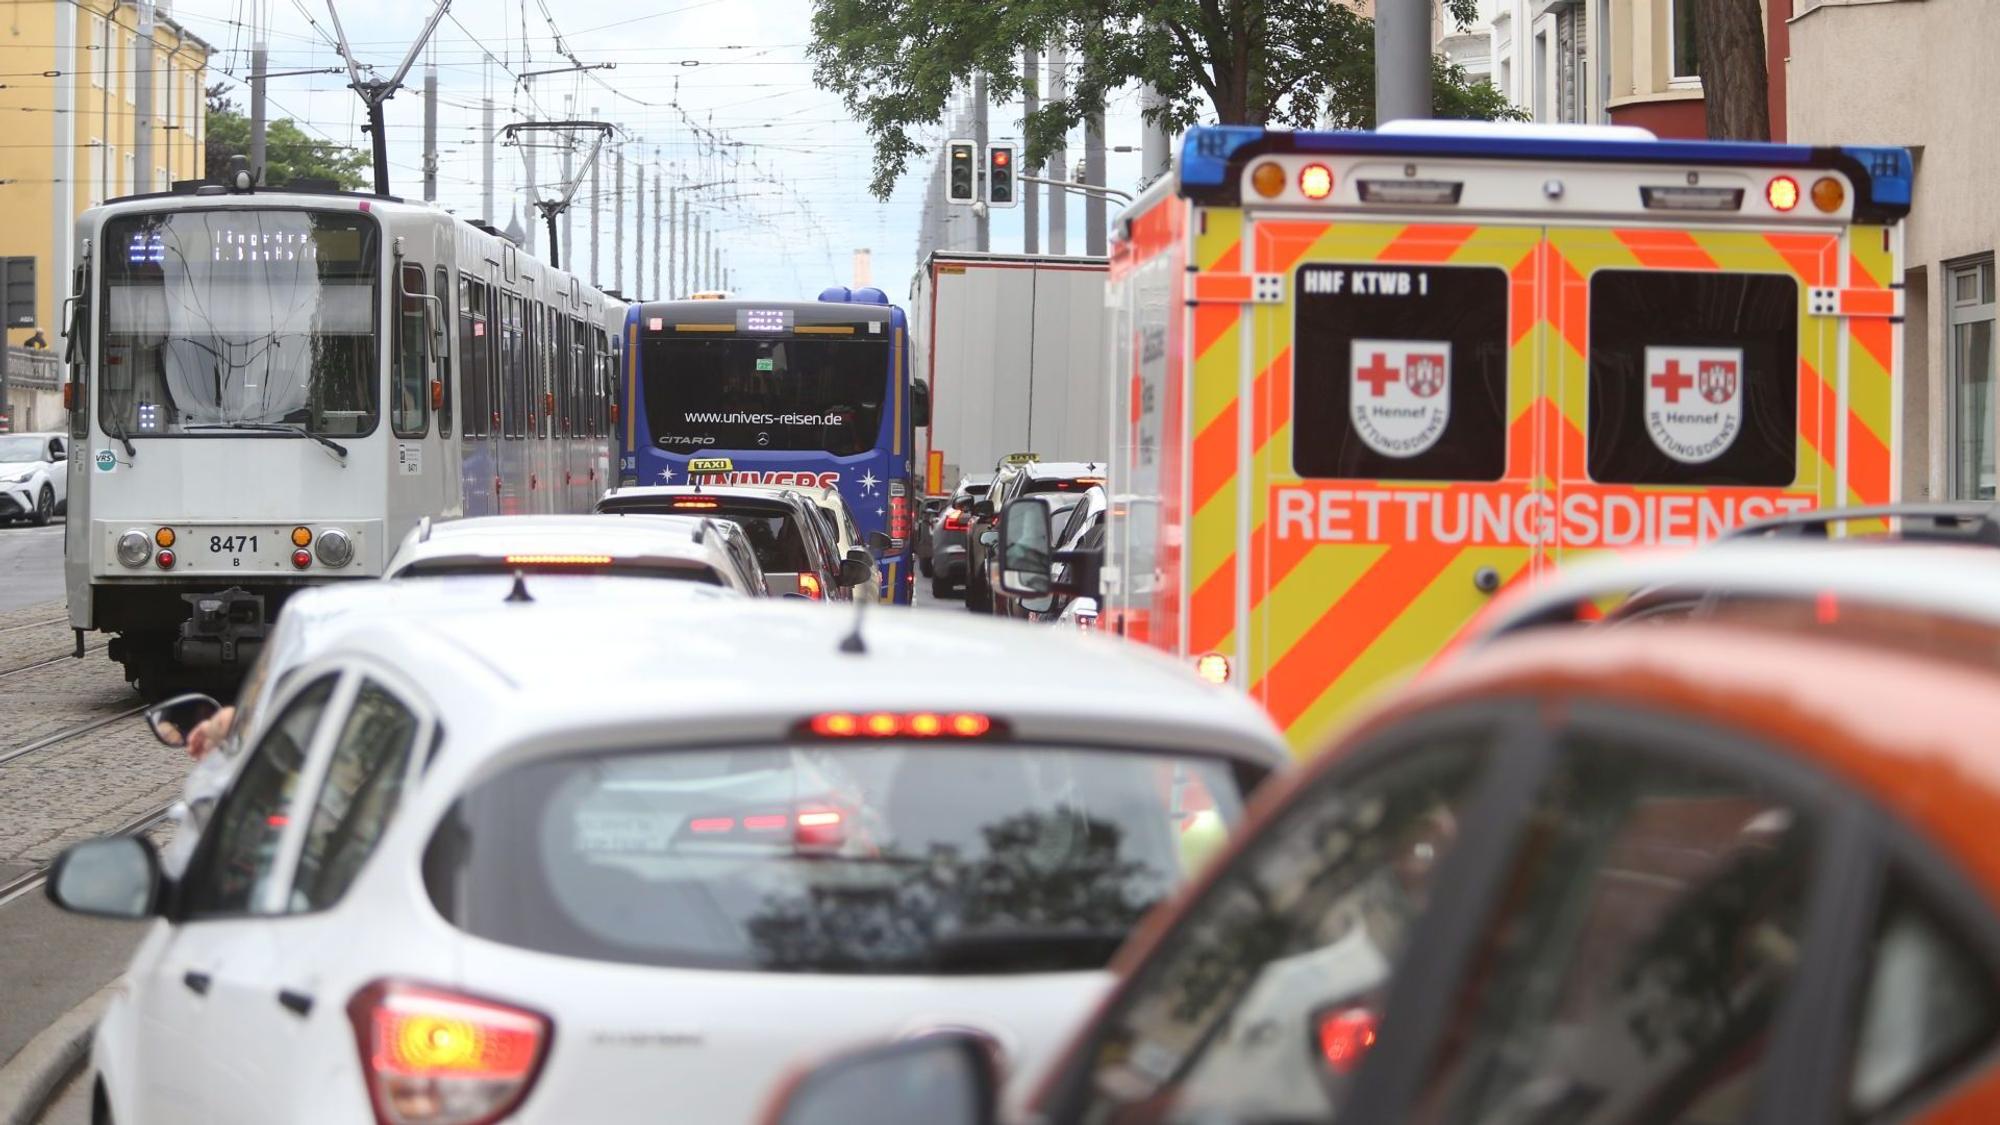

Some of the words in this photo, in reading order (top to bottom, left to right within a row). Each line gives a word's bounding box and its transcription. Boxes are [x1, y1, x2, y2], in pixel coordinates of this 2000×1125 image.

[1304, 269, 1344, 293] HNF
[1352, 271, 1410, 295] KTWB
[1418, 273, 1427, 295] 1
[684, 411, 842, 426] www.univers-reisen.de
[1372, 405, 1426, 418] Hennef
[1666, 412, 1718, 424] Hennef
[1356, 405, 1444, 450] RETTUNGSDIENST
[1651, 411, 1735, 457] RETTUNGSDIENST
[659, 436, 715, 445] CITARO
[210, 536, 257, 553] 8471
[233, 558, 240, 567] B
